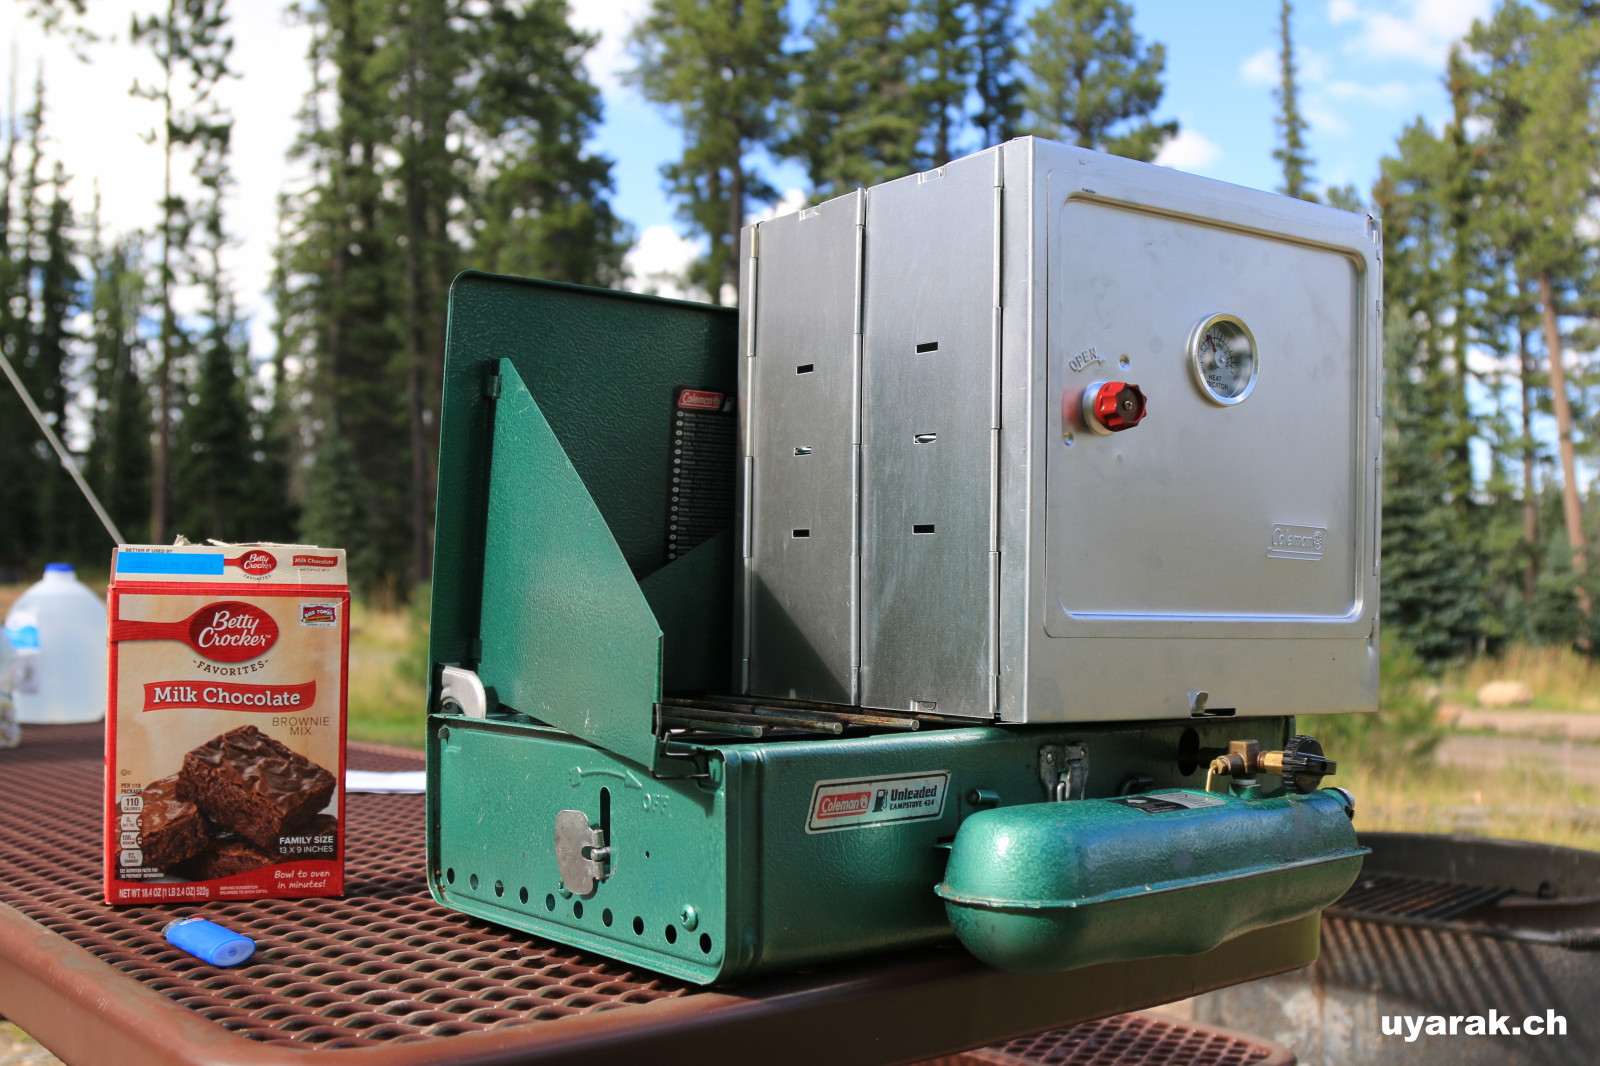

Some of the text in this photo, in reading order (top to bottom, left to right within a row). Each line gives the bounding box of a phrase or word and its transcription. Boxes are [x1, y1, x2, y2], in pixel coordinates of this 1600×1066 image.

[1069, 347, 1097, 372] OPEN
[682, 392, 713, 405] Coleman
[1272, 528, 1313, 548] Coleman
[249, 553, 269, 563] Betty
[213, 611, 259, 635] Betty
[153, 686, 301, 706] Milk Chocolate
[272, 717, 330, 726] BROWNIE
[290, 727, 312, 735] MIX
[126, 797, 139, 806] 110
[821, 785, 938, 812] Coleman Unleaded
[889, 800, 923, 810] CAMPSTOVE
[279, 836, 334, 845] FAMILY SIZE
[279, 846, 287, 854] 13
[296, 846, 302, 854] 9
[303, 845, 334, 853] INCHES
[274, 870, 295, 879] Bowl
[297, 870, 308, 878] to
[277, 879, 327, 889] in minutes!
[119, 889, 130, 898] NET
[130, 889, 140, 898] WT
[142, 888, 153, 897] 18.4
[153, 888, 162, 897] OZ
[168, 887, 176, 897] LB
[176, 887, 185, 896] 2.4
[185, 886, 195, 897] OZ)
[196, 886, 209, 897] 522g
